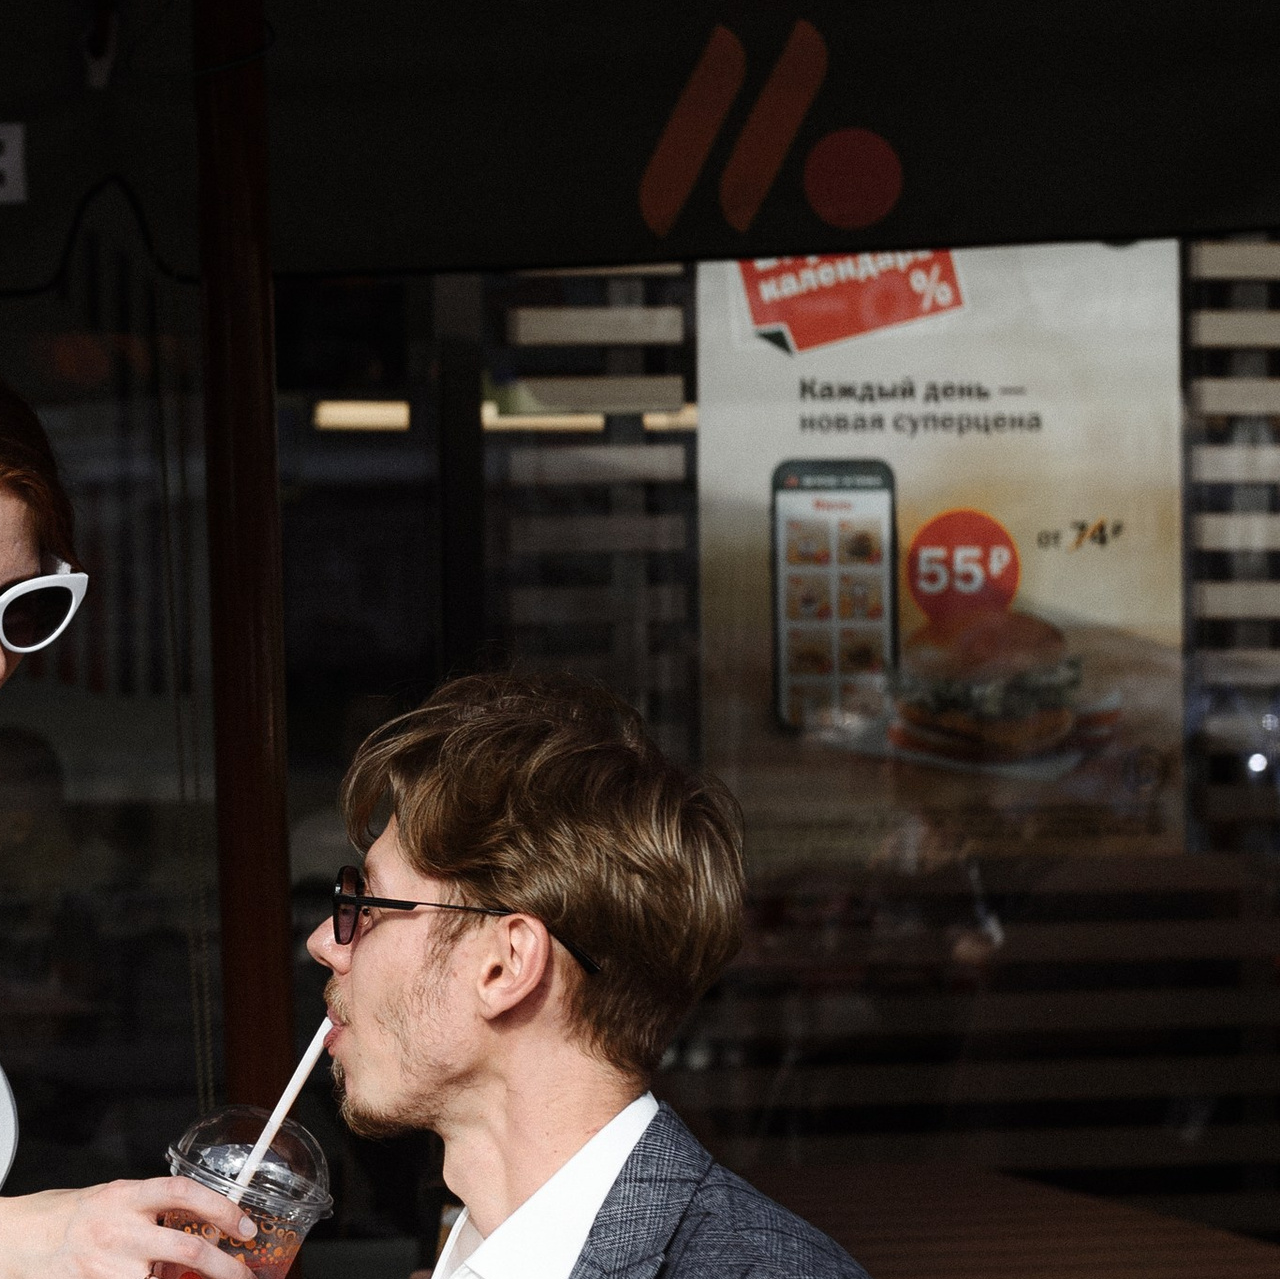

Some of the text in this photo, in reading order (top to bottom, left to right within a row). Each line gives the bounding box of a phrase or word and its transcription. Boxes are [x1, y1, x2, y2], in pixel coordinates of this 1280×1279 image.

[908, 263, 953, 312] %
[800, 377, 915, 403] Каждый
[924, 381, 991, 403] день
[800, 412, 1042, 439] новая суперцена
